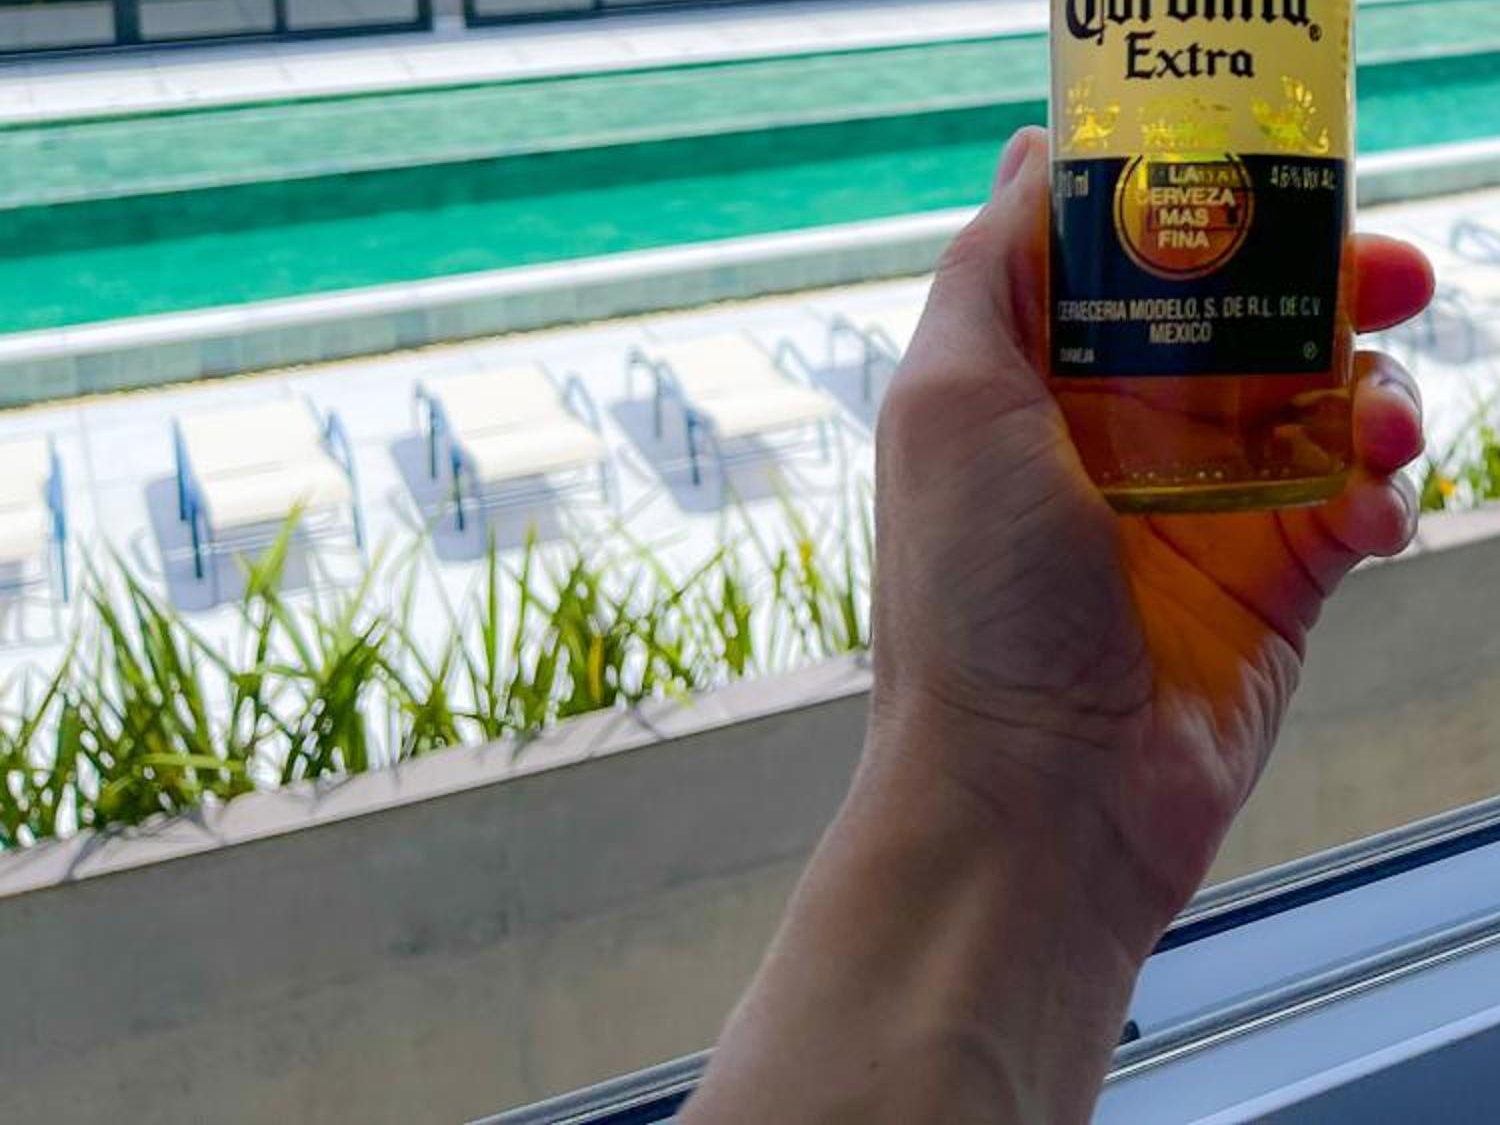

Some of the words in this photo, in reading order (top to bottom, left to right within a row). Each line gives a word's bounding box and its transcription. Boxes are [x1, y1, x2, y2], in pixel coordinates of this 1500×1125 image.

[1124, 30, 1254, 79] Extra
[1168, 165, 1200, 183] LA
[1135, 186, 1236, 207] CERVEZA
[1159, 207, 1209, 227] MAS
[1157, 230, 1210, 250] FINA
[1222, 295, 1244, 318] DE
[1279, 294, 1298, 316] DE
[1149, 322, 1212, 343] MEXICO
